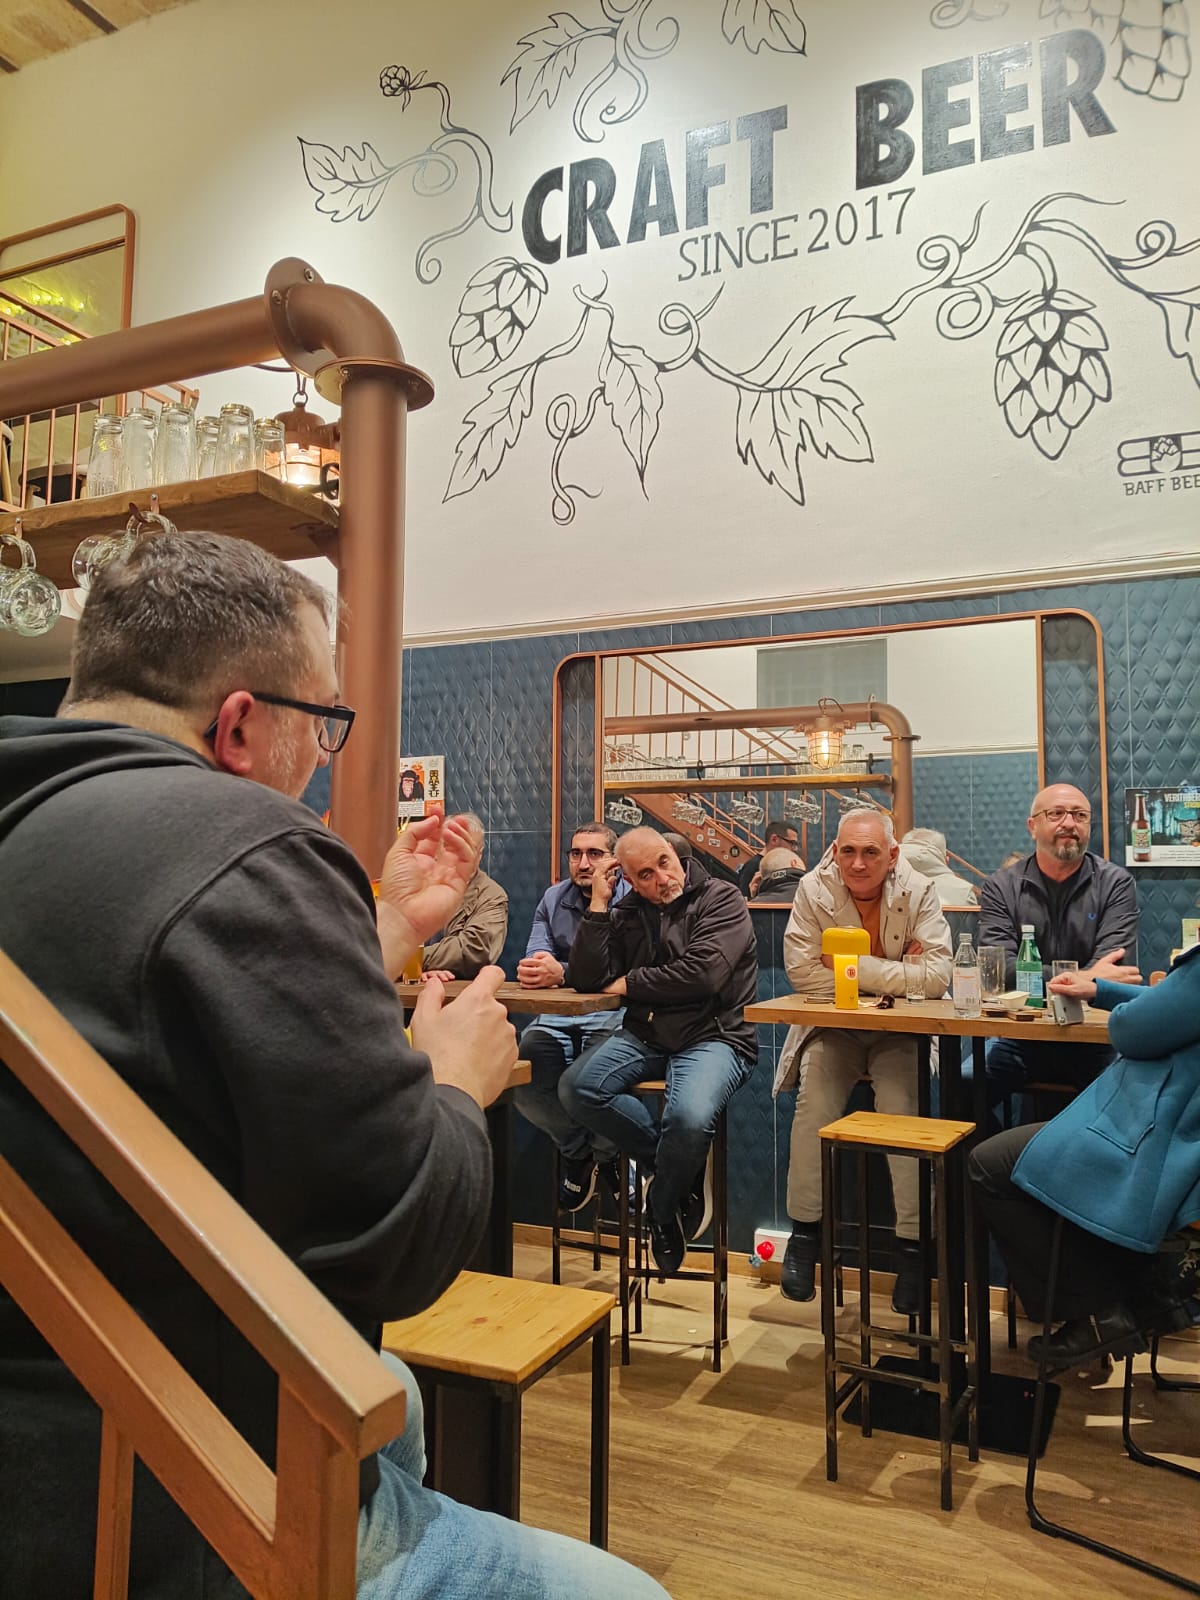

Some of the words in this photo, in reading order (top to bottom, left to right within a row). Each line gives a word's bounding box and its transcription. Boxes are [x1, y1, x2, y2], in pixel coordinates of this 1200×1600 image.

[521, 105, 787, 264] CRAFT
[855, 29, 1117, 190] BEER
[678, 215, 799, 282] SINCE
[806, 188, 916, 252] 2017
[1123, 479, 1166, 496] BAFF
